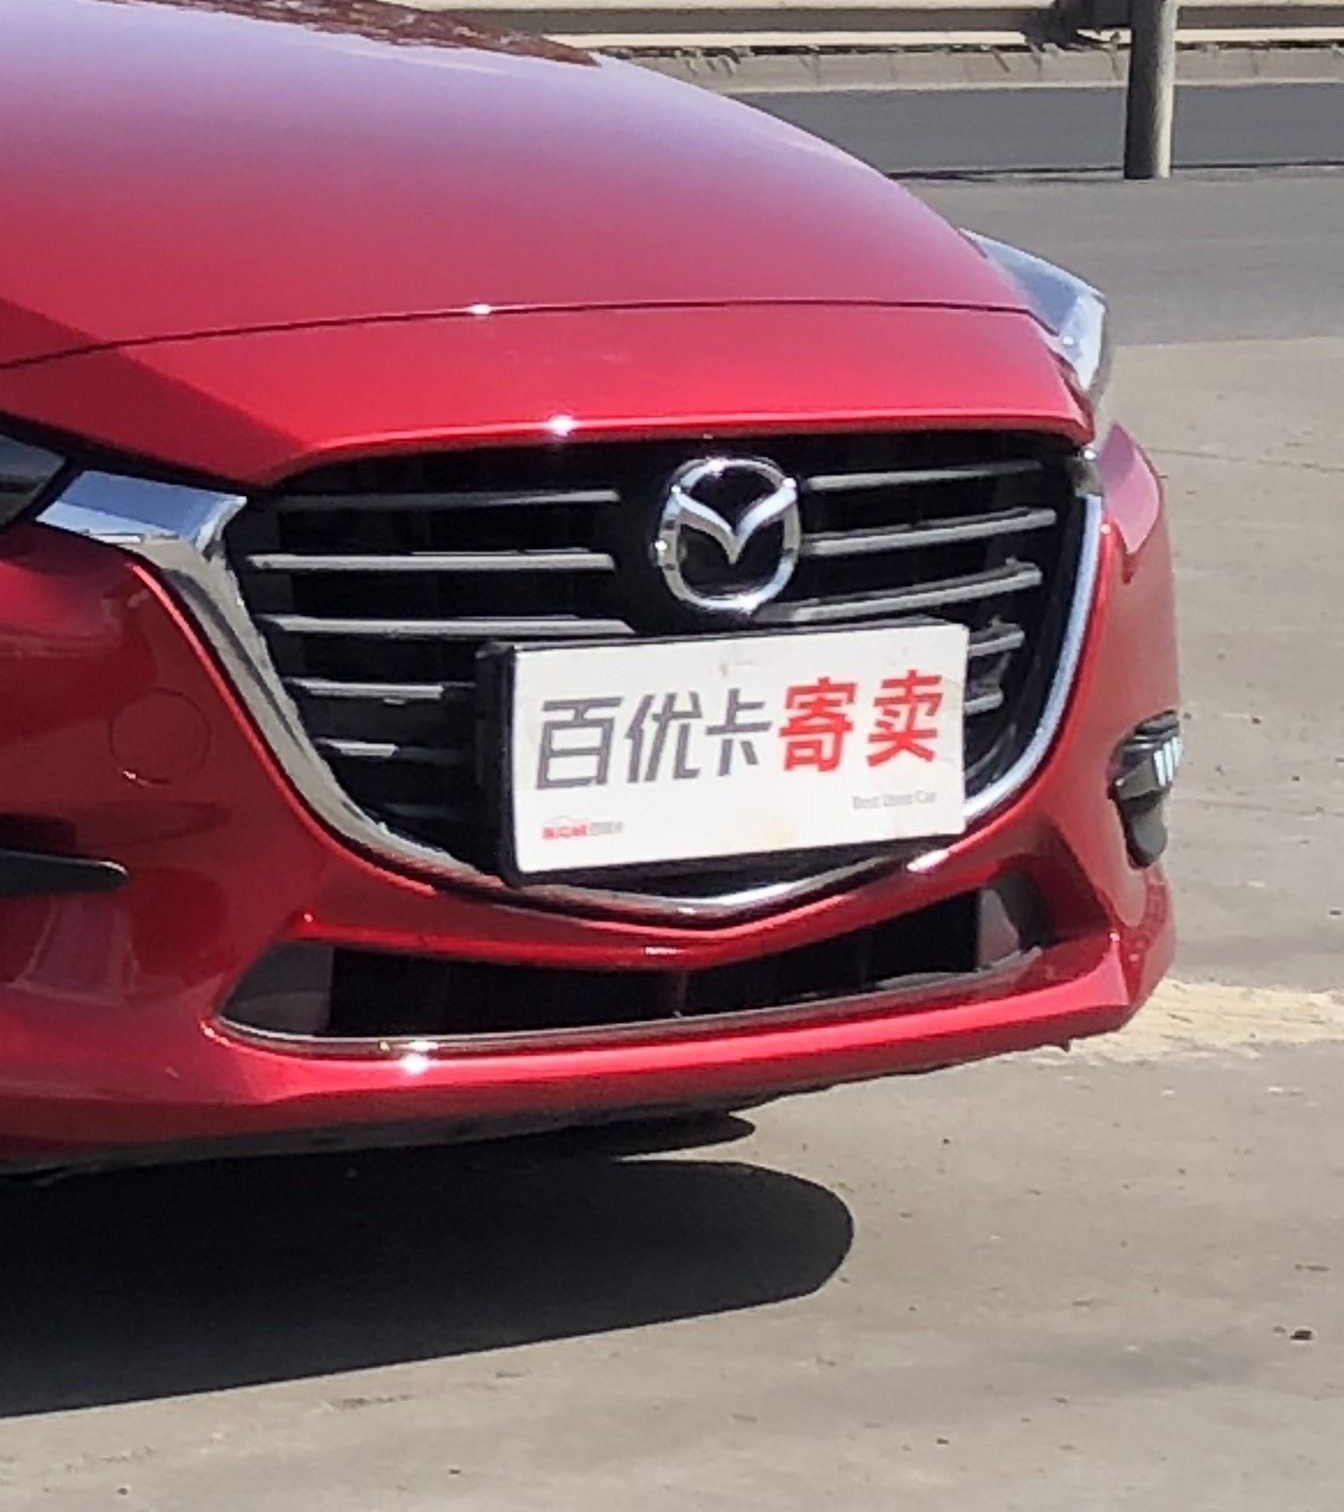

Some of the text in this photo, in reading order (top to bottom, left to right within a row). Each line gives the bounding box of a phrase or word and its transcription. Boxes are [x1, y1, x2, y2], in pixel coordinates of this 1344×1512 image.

[535, 669, 943, 789] 百优卡寄卖
